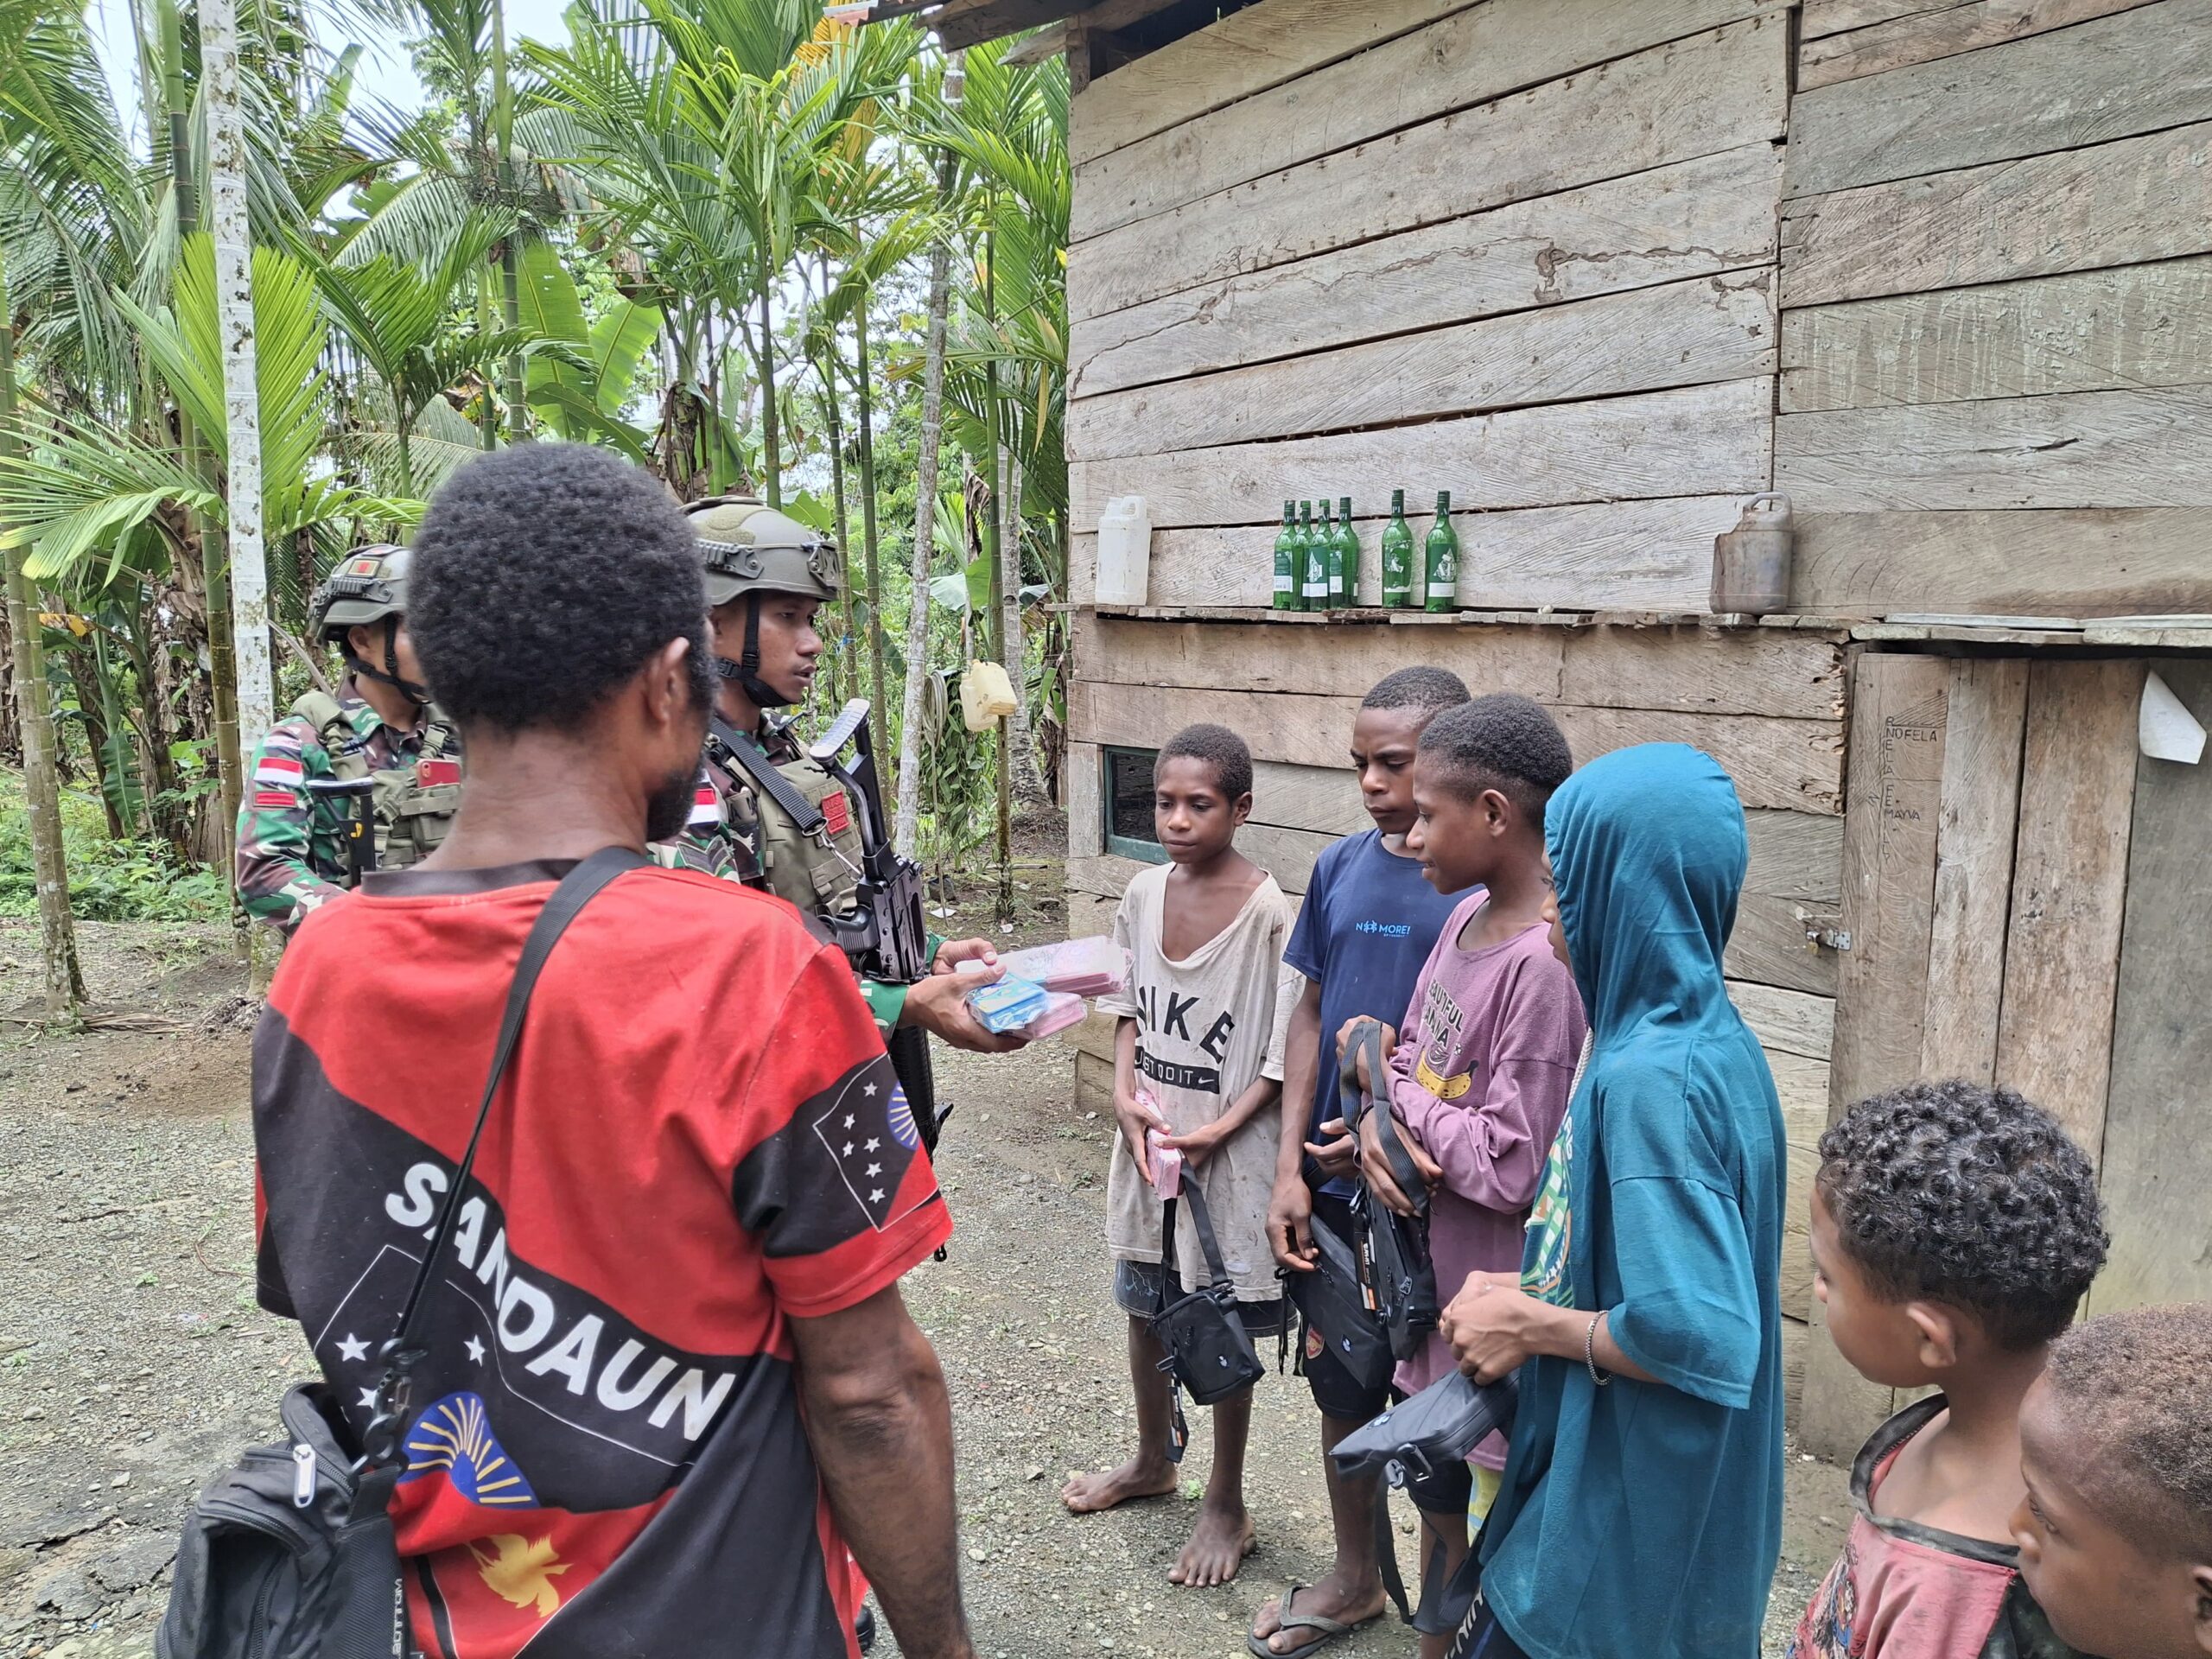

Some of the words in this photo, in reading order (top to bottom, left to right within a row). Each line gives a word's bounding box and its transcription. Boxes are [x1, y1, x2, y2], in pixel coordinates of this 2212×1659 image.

[1378, 924, 1411, 935] MORE!
[1157, 1064, 1175, 1081] DO
[1179, 1068, 1194, 1085] IT
[385, 1162, 736, 1441] SANDAUN
